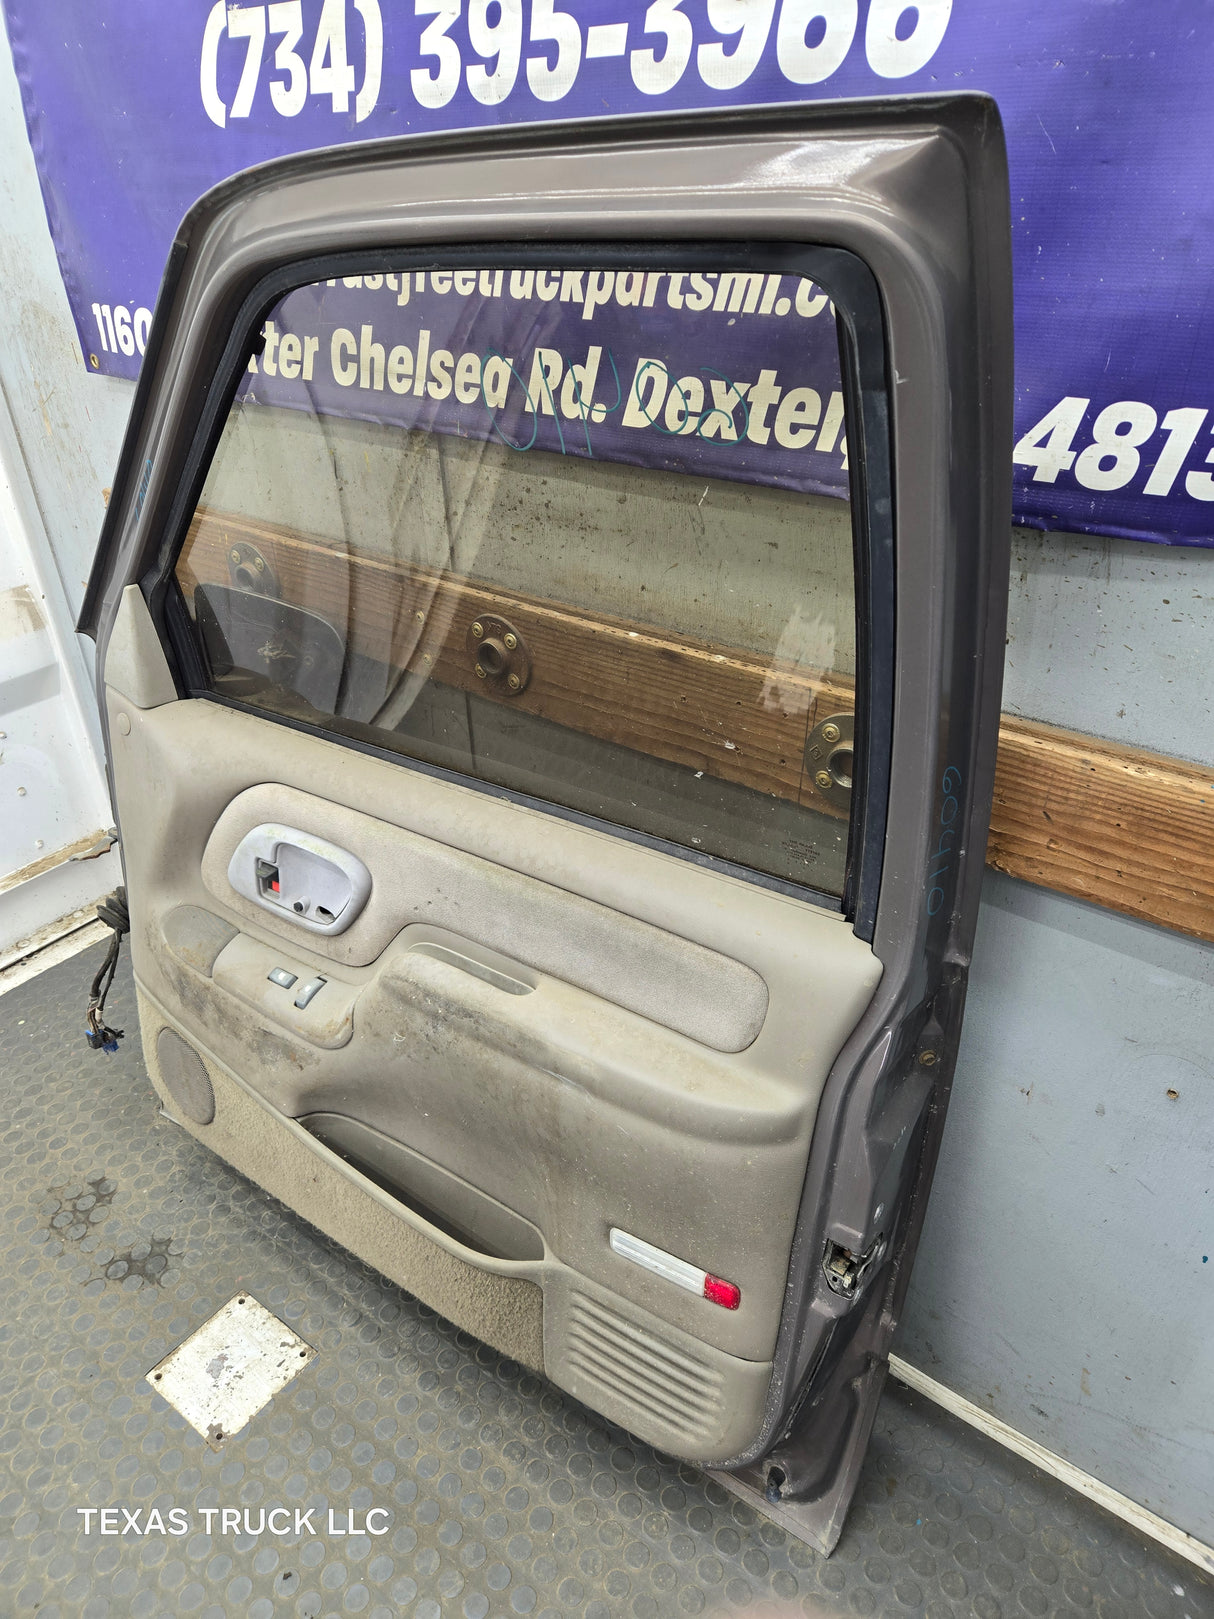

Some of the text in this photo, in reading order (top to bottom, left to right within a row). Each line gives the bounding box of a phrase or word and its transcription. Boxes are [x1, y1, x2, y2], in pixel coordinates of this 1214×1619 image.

[200, 0, 383, 128] (734)
[331, 325, 513, 408] Chelsea
[524, 345, 607, 423] Rd.
